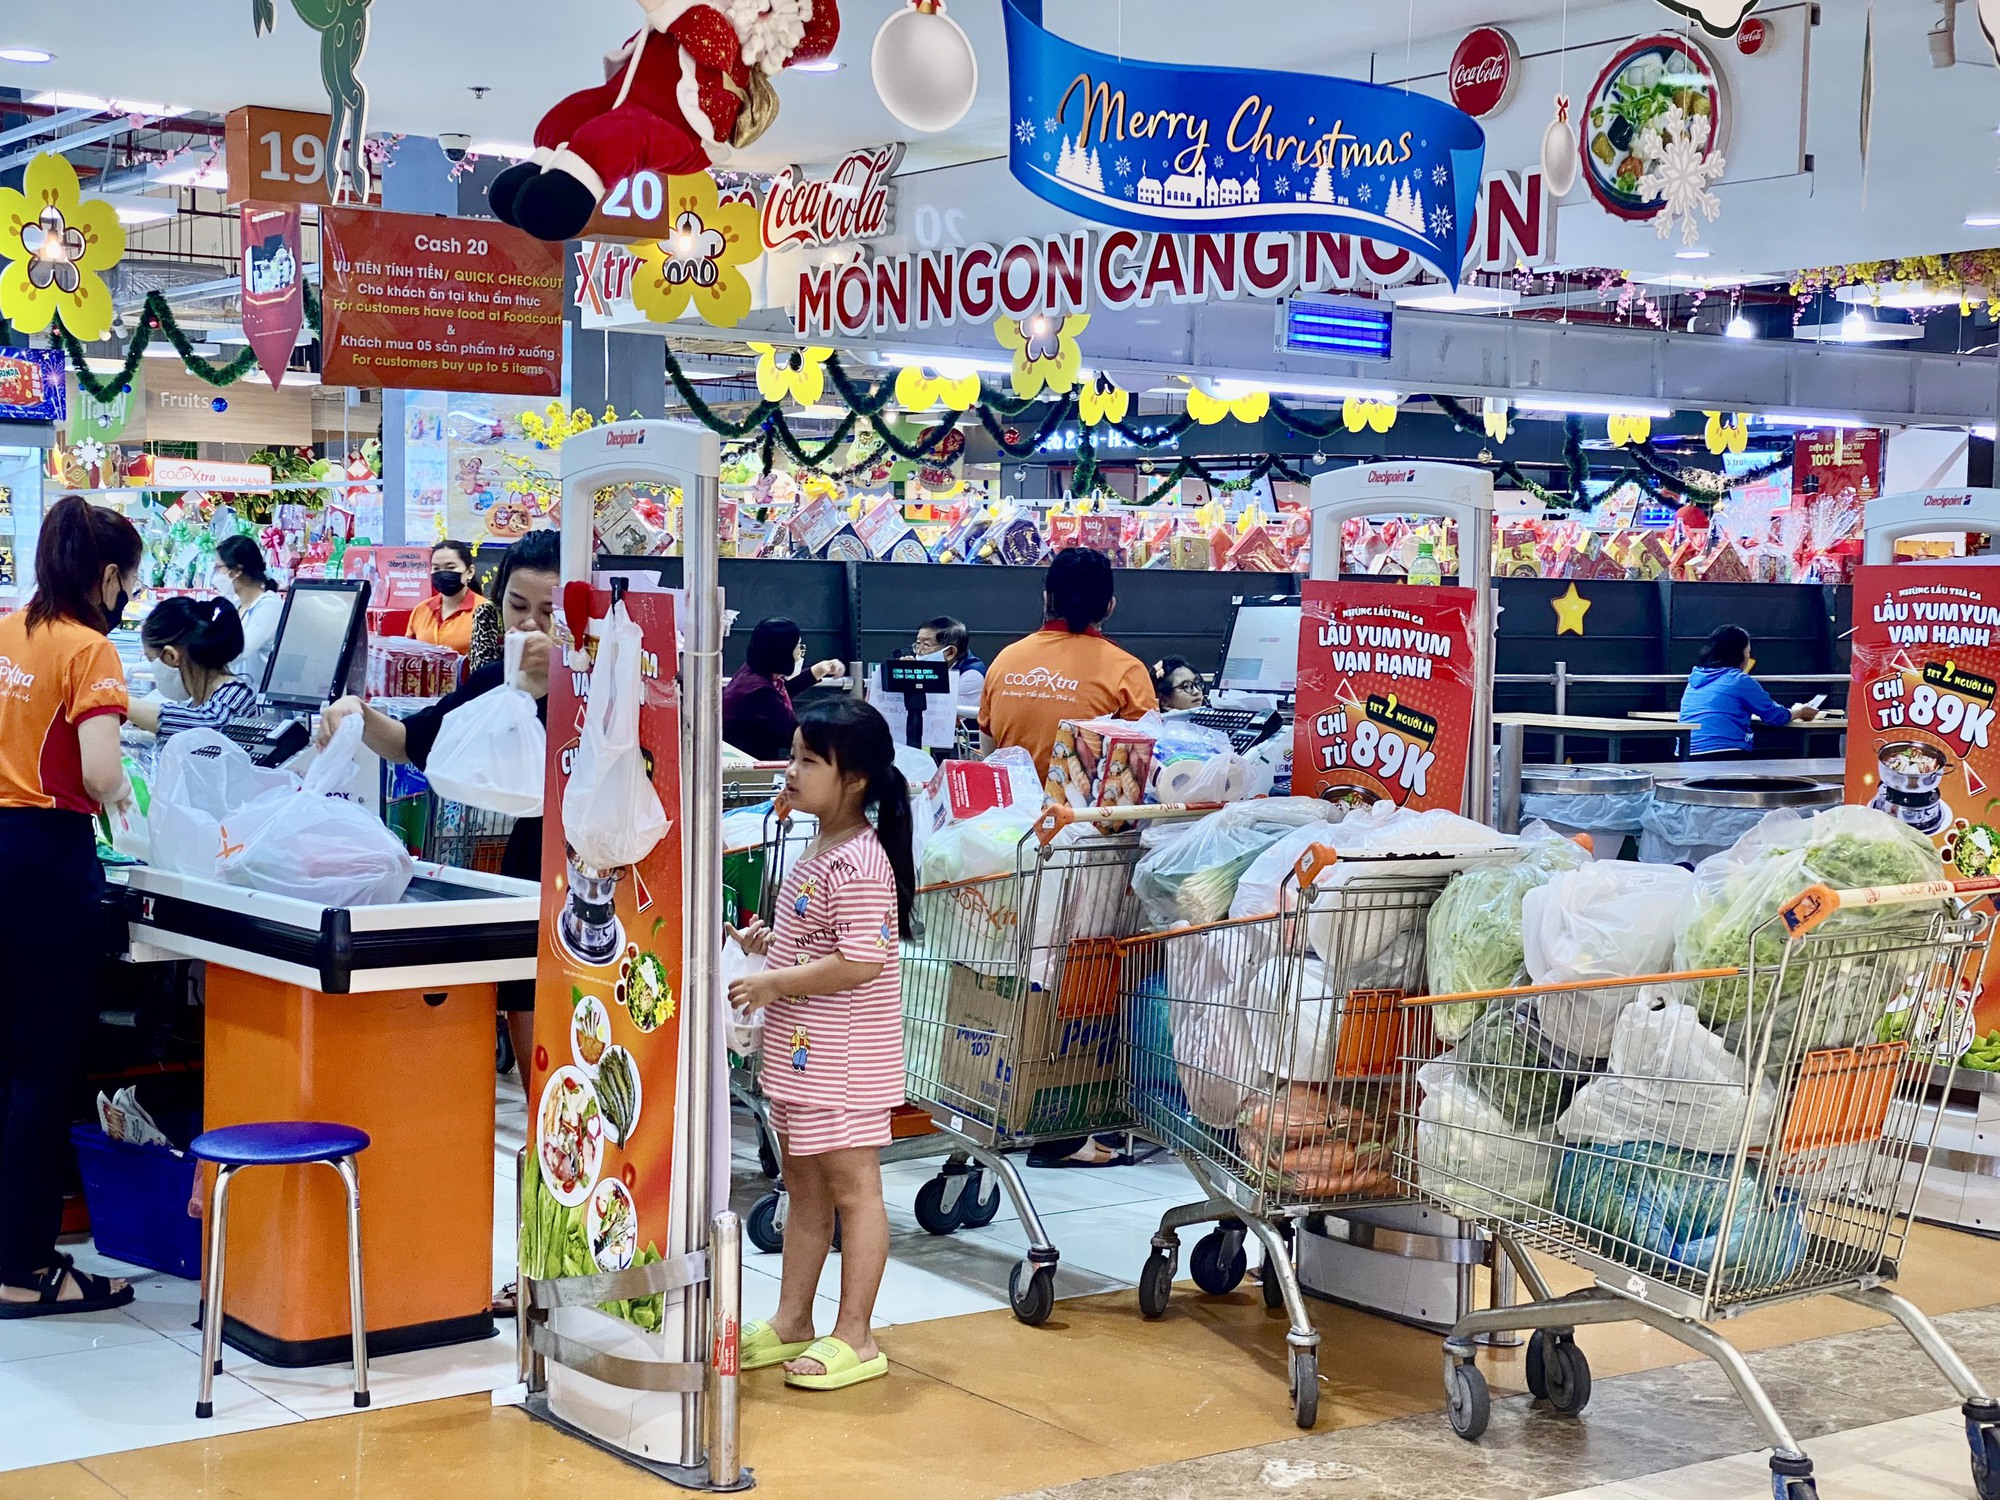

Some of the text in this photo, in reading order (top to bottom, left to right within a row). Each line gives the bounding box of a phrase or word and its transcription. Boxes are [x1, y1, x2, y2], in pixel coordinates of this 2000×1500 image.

[1056, 73, 1414, 174] Merry Christmas
[260, 131, 325, 184] 19
[602, 171, 663, 220] 20
[414, 234, 489, 256] Cash 20
[355, 260, 381, 275] TIÊN
[385, 261, 413, 278] TÍNH
[454, 270, 494, 284] QUICK
[499, 274, 563, 289] CHECKOUT
[799, 251, 907, 335] MÓN
[920, 237, 1084, 322] NGON
[358, 283, 383, 295] Cho
[387, 282, 425, 298] khách
[429, 287, 445, 299] ăn
[448, 289, 464, 303] tại
[468, 291, 489, 303] khu
[515, 295, 541, 309] thực
[333, 300, 562, 325] For customers have food at Foodcourt
[447, 324, 456, 335] &
[341, 335, 555, 361] Khách mua 05 sản phẩm trở xuống
[352, 354, 544, 375] For customers buy up to 5 items
[160, 391, 209, 409] Fruits
[606, 430, 638, 448] Checkpoint
[1368, 470, 1406, 485] Checkpoint
[1924, 494, 1962, 508] Checkpoint
[1873, 592, 1908, 622] LẨU
[1318, 612, 1451, 658] LẨU YUMYUM
[1888, 625, 1990, 649] VẠN HẠNH
[1332, 651, 1432, 680] VẠN HẠNH
[1926, 668, 1942, 679] SET
[1942, 660, 1956, 683] 2
[1954, 676, 1981, 691] NGƯỜI
[1370, 701, 1384, 714] SET
[1385, 693, 1397, 719] 2
[1396, 712, 1422, 730] NGƯỜI
[1872, 671, 1996, 748] CHỈ 89K
[1878, 701, 1905, 727] TỪ
[1317, 704, 1435, 796] CHỈ 89K
[1322, 737, 1348, 767] TỪ
